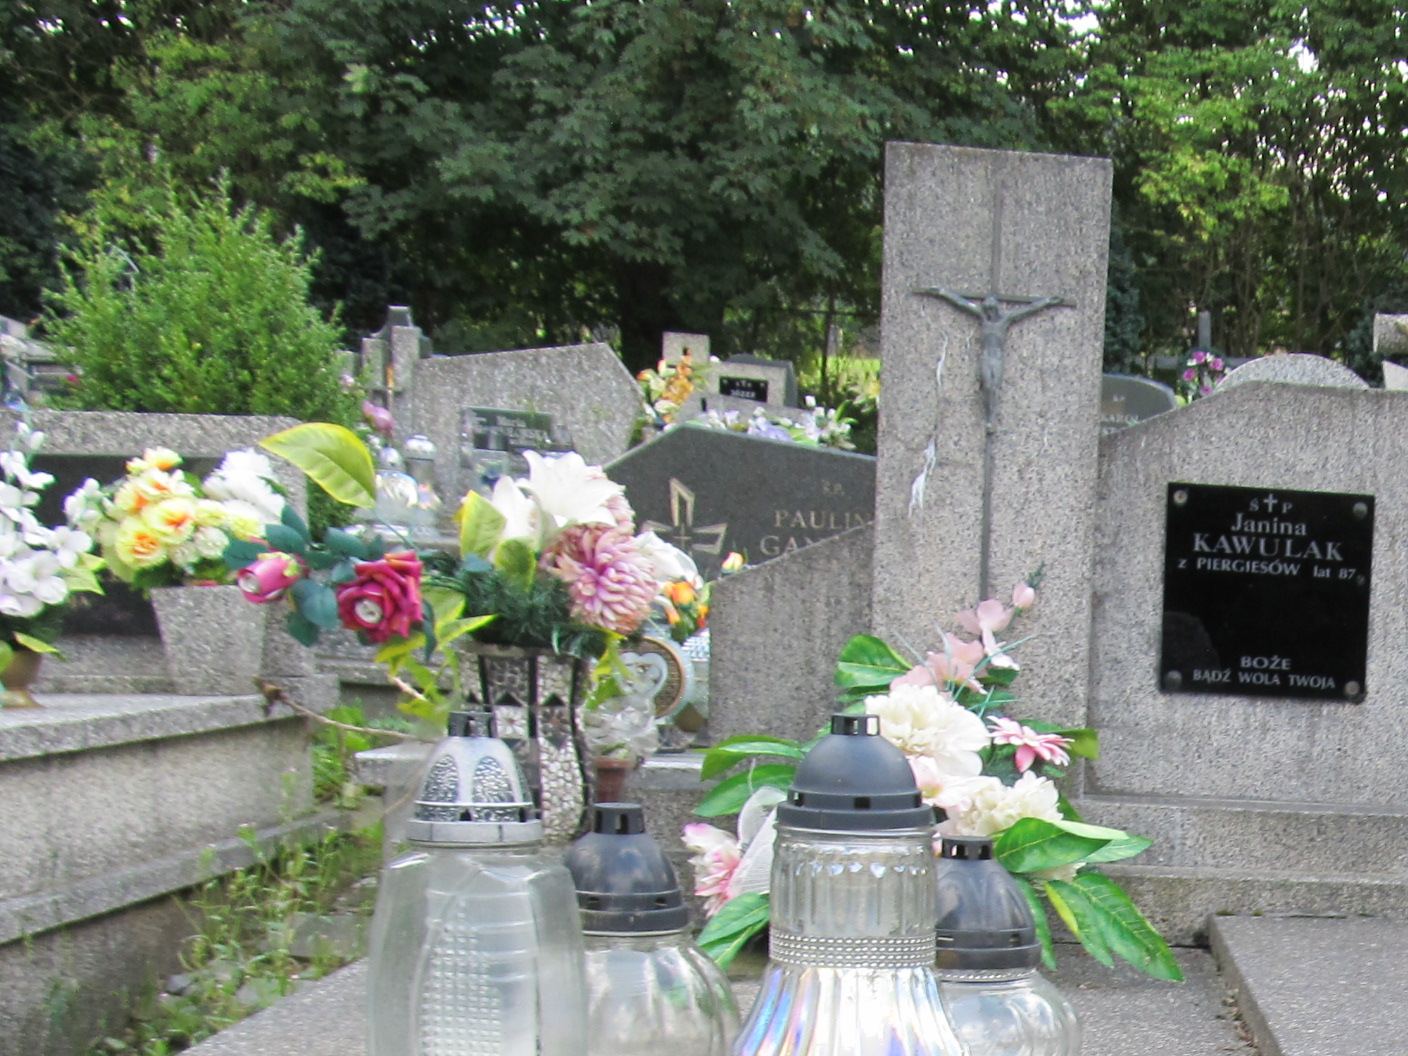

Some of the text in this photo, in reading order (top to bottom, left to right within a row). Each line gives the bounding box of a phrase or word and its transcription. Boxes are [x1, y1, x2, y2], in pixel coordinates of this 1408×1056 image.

[1231, 512, 1308, 536] Janina
[1192, 532, 1344, 561] KAWULAK
[1178, 556, 1357, 580] z PIERGIESÓW lat 87
[1240, 655, 1292, 671] BOŻE
[1192, 667, 1336, 690] BĄDŹ WOLA TWOJA
